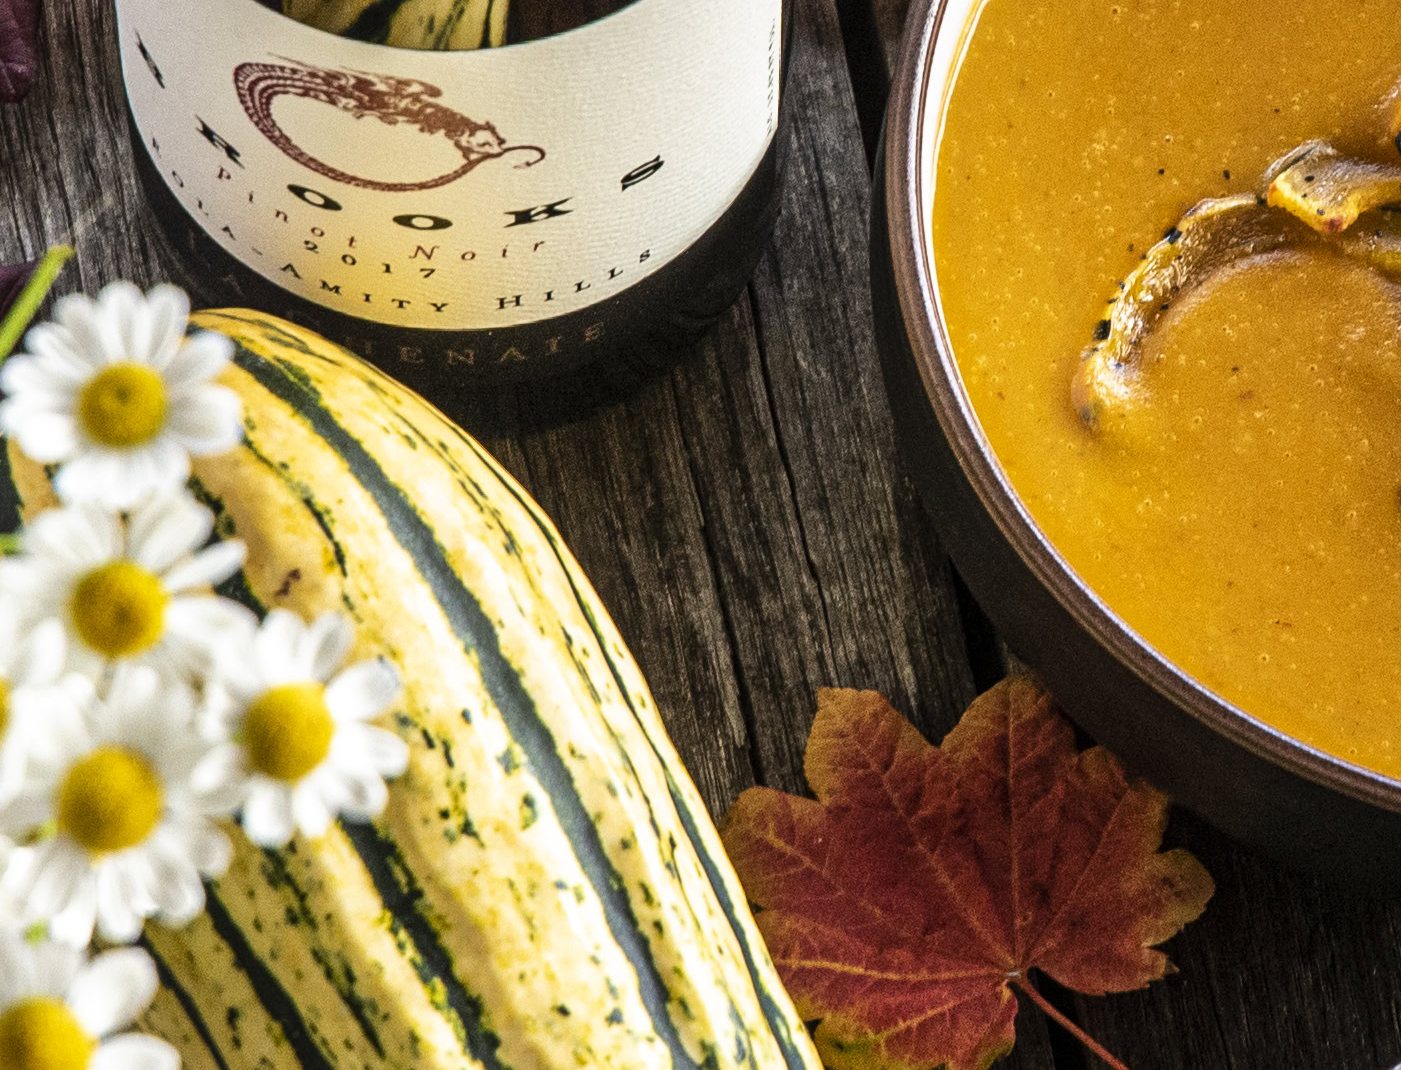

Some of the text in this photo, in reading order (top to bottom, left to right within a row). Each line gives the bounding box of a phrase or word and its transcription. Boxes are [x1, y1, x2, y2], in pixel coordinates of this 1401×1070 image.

[303, 240, 436, 278] 2017
[408, 241, 546, 261] Noir
[495, 249, 651, 310] HILLS
